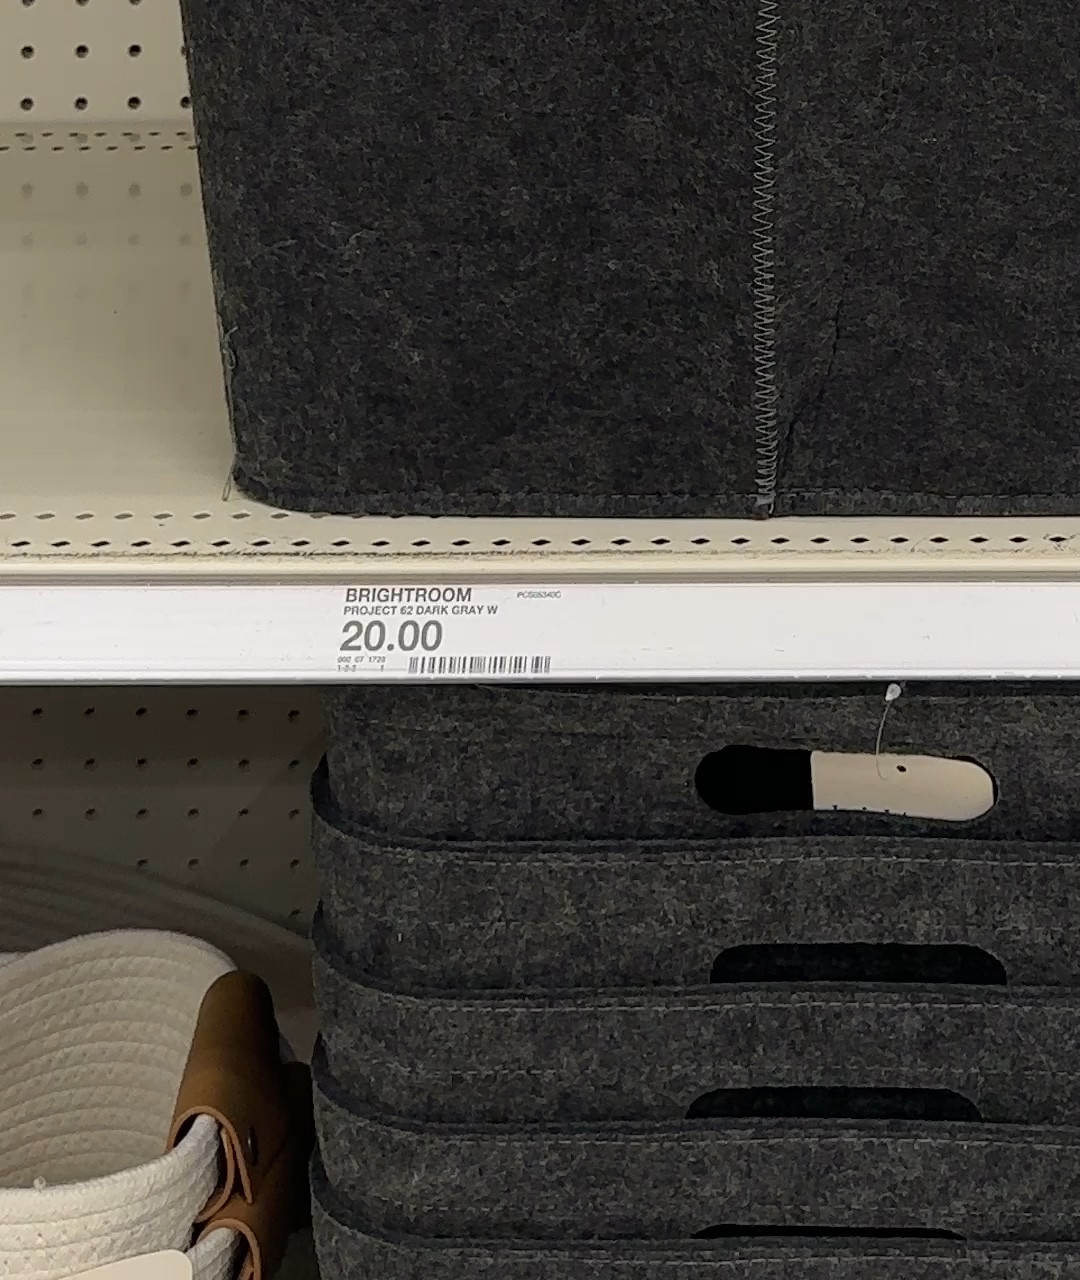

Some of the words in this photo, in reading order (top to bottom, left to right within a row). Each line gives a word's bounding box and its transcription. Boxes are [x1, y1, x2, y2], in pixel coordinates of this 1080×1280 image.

[346, 588, 473, 602] BRIGHTROOM
[344, 606, 397, 615] PROJECT
[400, 606, 414, 615] 62
[416, 606, 448, 615] DARK
[451, 605, 484, 615] GRAY
[487, 605, 498, 615] W
[340, 620, 443, 651] 20.00
